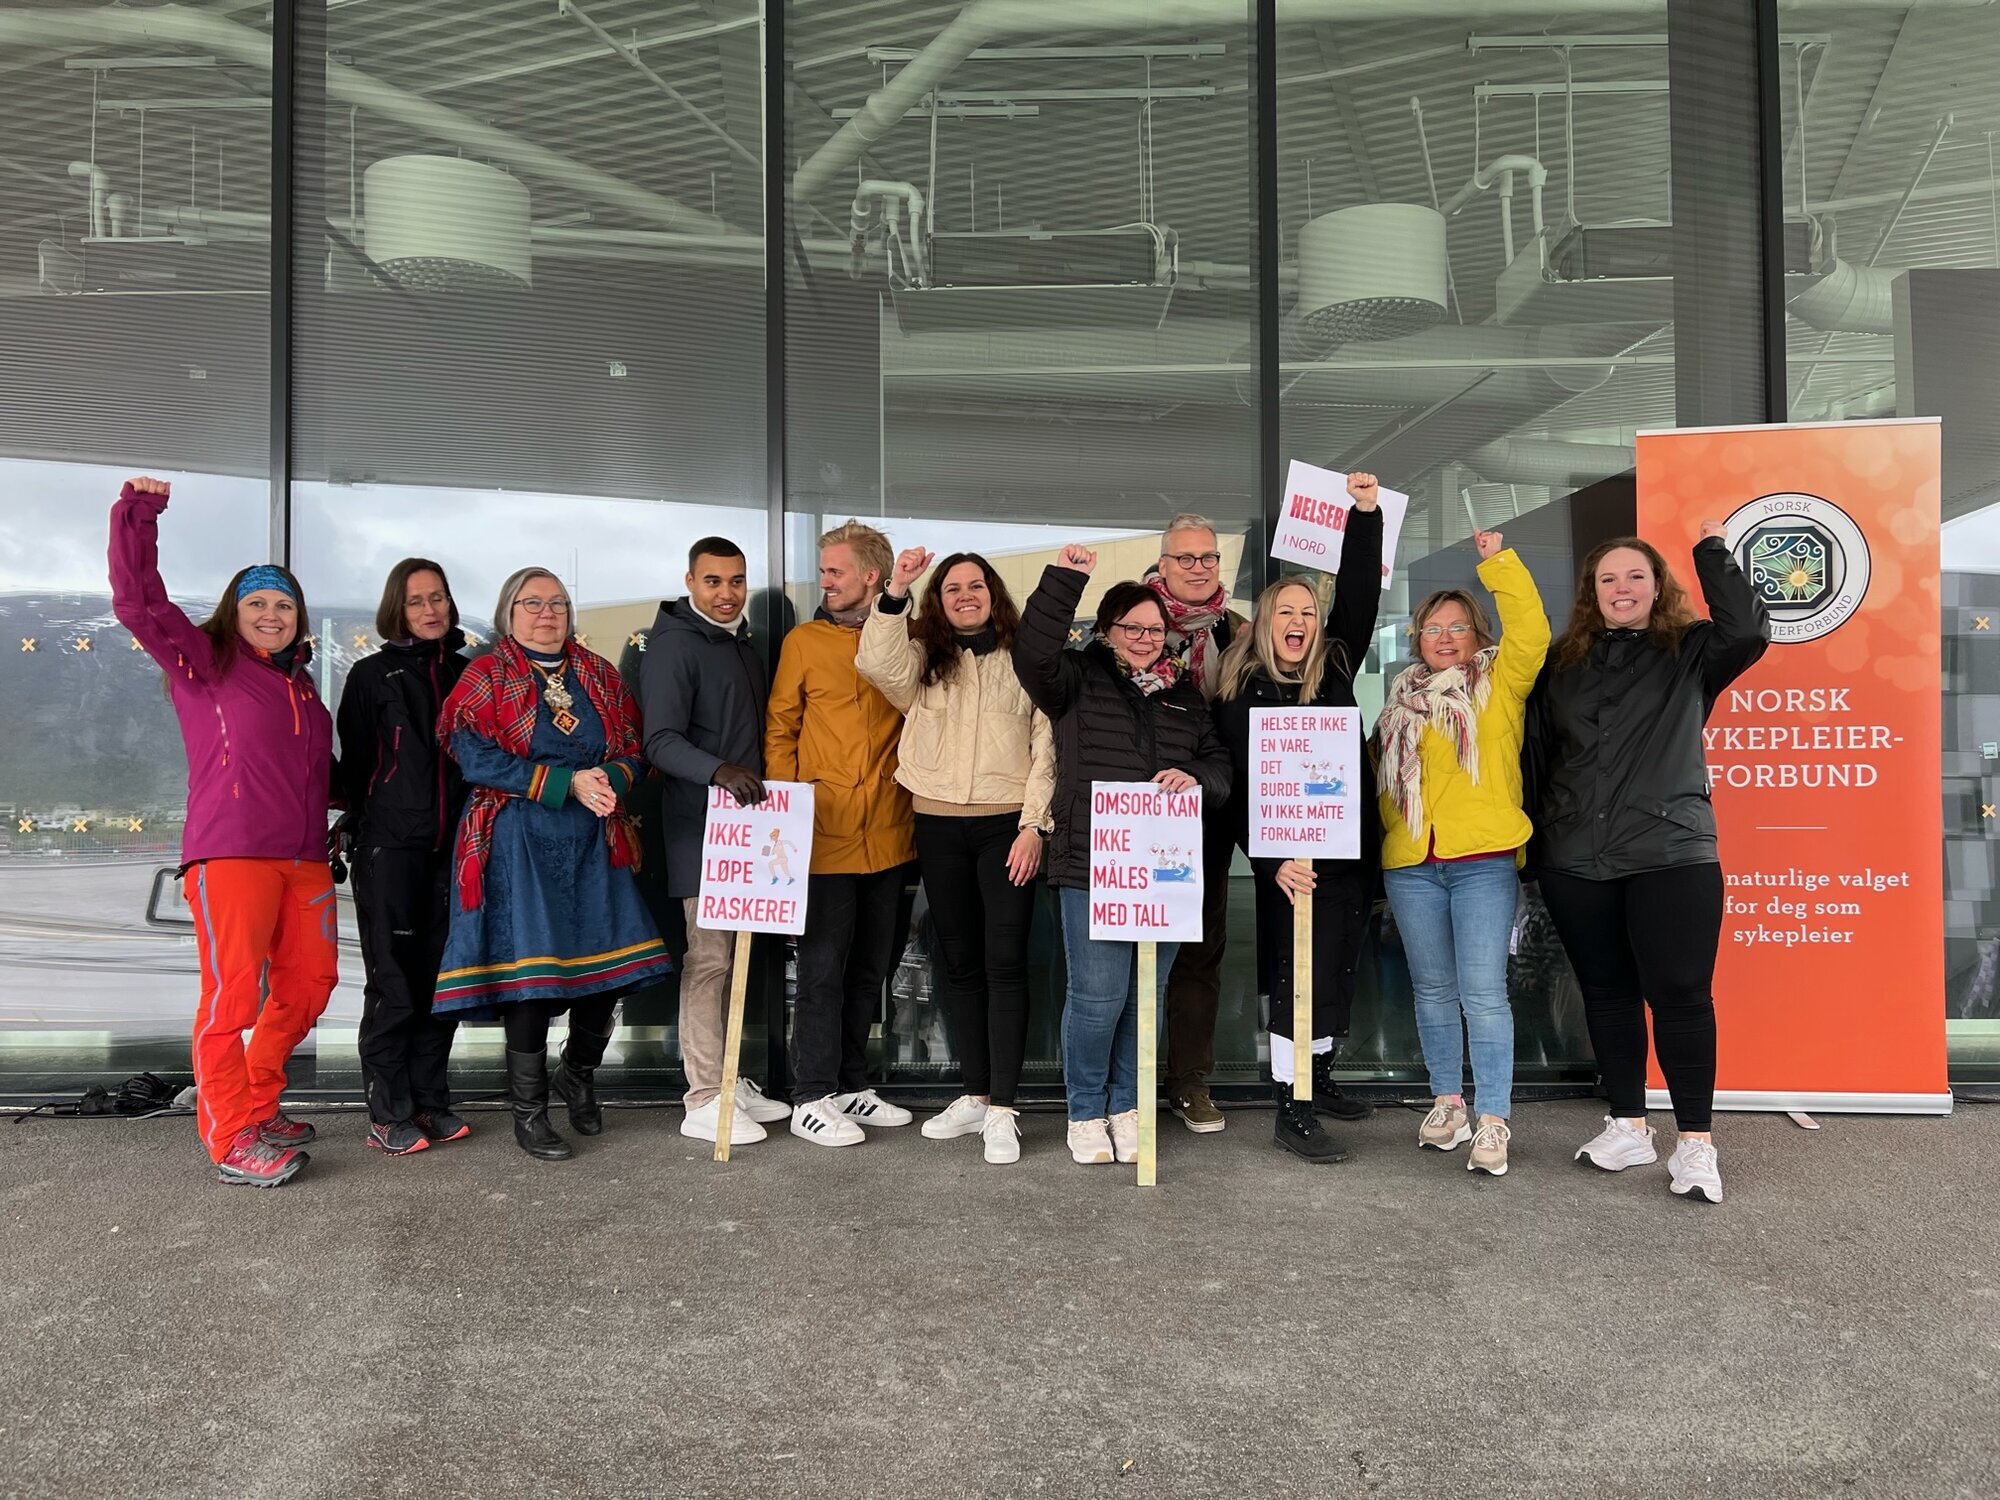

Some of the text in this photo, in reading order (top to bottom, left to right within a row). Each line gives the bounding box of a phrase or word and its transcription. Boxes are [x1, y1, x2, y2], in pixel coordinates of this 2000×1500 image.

[1290, 494, 1349, 533] HELSEB
[1763, 501, 1811, 514] NORSK
[1282, 534, 1326, 555] I NORD
[1771, 594, 1852, 635] IERFORBUND
[1730, 688, 1850, 712] NORSK
[1261, 717, 1347, 732] HELSE ER IKKE
[1261, 738, 1313, 753] EN VARE,
[1702, 725, 1904, 750] YKEPLEIER-
[1261, 760, 1282, 775] DET
[1706, 764, 1878, 788] FORBUND
[711, 787, 742, 810] JE
[1261, 782, 1300, 797] BURDE
[1094, 792, 1199, 817] OMSORG KAN
[1261, 801, 1344, 819] VI IKKE MÅTTE
[708, 823, 752, 847] IKKE
[1094, 829, 1131, 852] IKKE
[1261, 827, 1326, 842] FORKLARE!
[706, 859, 753, 884] LØPE
[1093, 859, 1148, 889] MÅLES
[1726, 868, 1910, 891] naturlige valget
[703, 896, 797, 924] RASKERE!
[1093, 903, 1169, 927] MED TALL
[1725, 896, 1861, 919] for deg som
[1733, 924, 1854, 947] sykepleier
